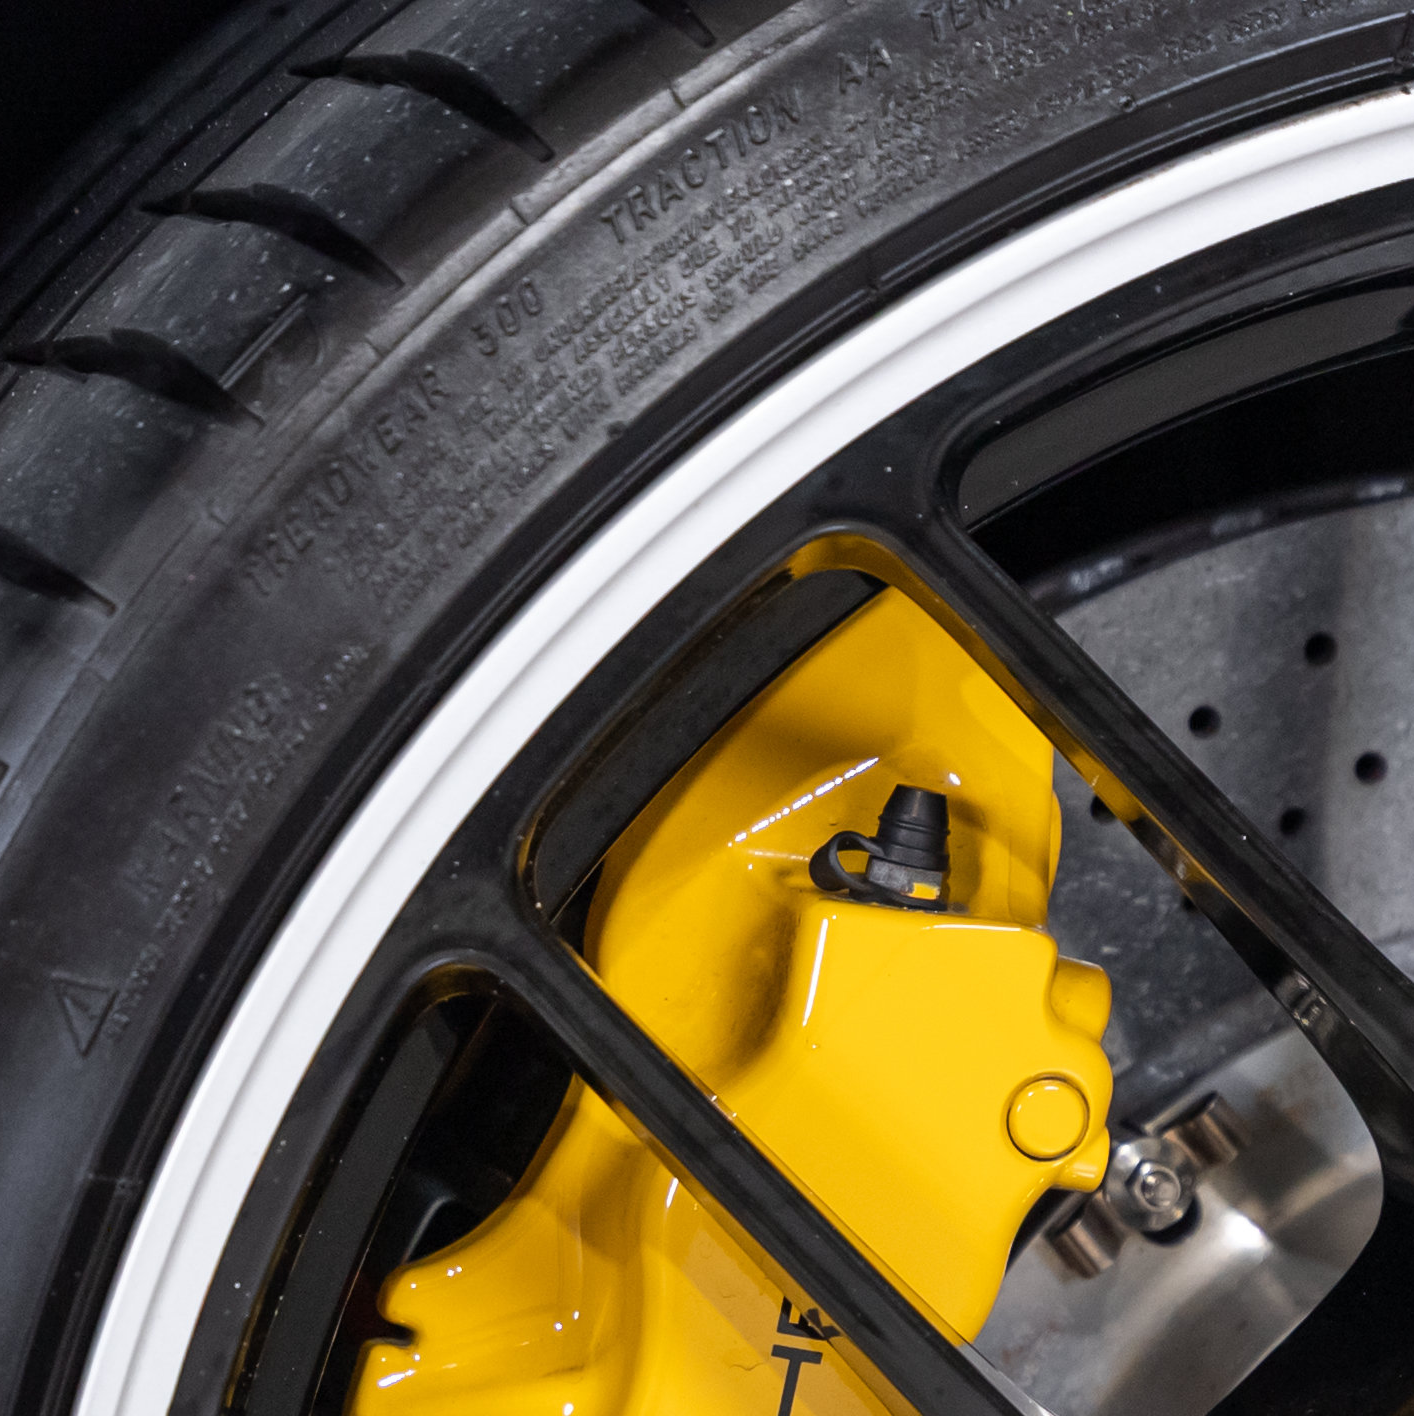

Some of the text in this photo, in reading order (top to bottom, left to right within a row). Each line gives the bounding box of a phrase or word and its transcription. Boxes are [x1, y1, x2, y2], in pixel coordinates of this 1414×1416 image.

[242, 364, 451, 596] TREADWEAR
[599, 88, 803, 246] TRACTION
[837, 38, 894, 95] AA
